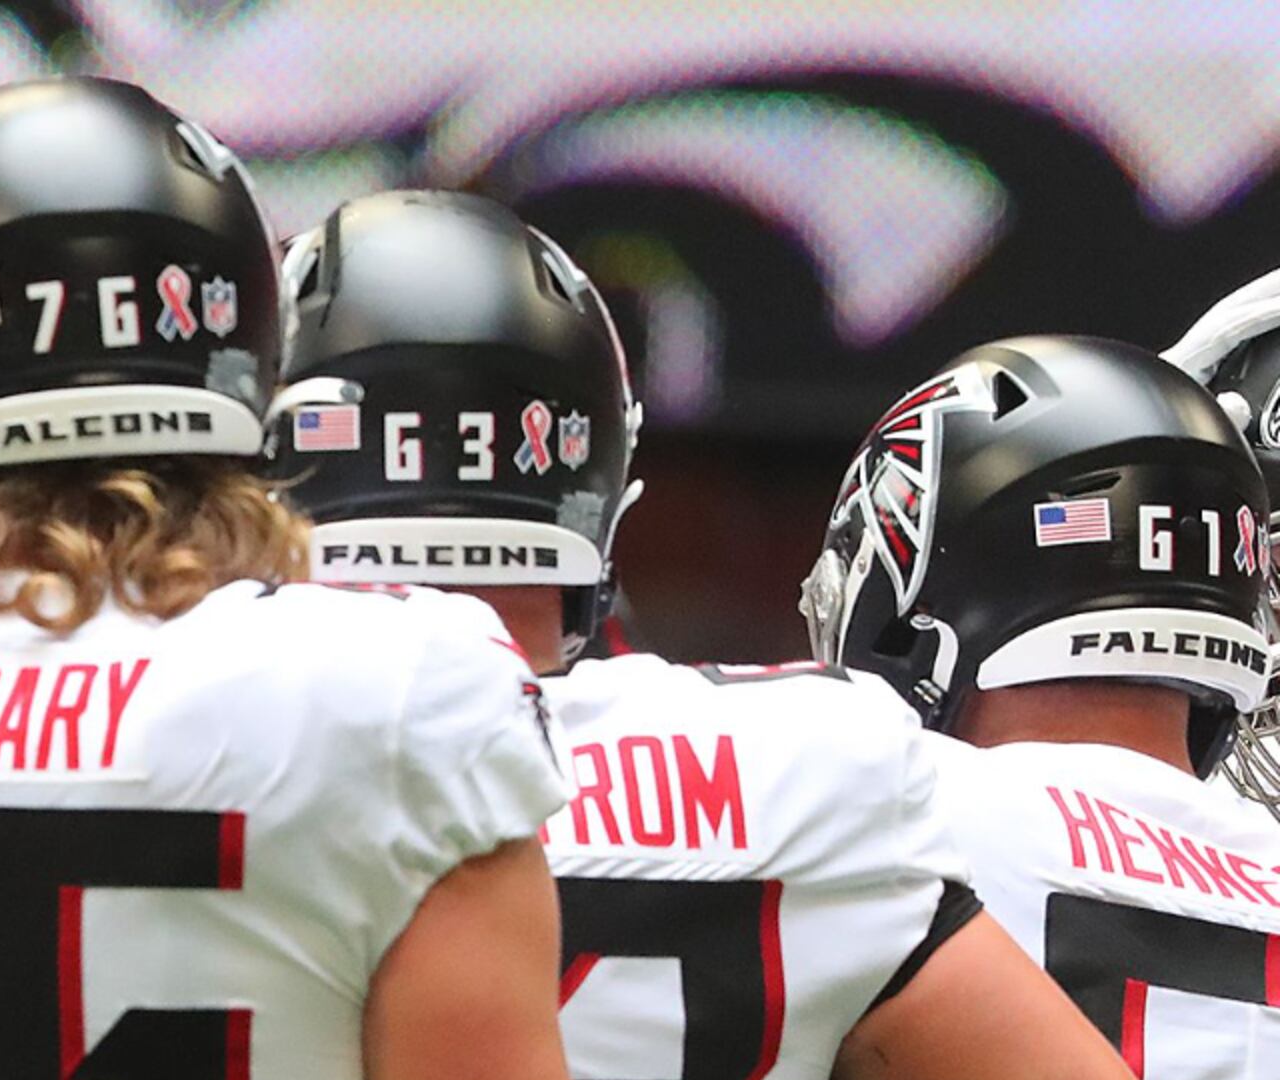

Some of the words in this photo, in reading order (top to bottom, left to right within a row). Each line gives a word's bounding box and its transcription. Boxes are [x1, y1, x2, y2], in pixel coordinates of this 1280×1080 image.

[25, 275, 143, 354] 76
[384, 411, 496, 481] 63
[322, 545, 559, 569] FALCONS
[1139, 505, 1220, 577] 61
[1070, 631, 1267, 676] FALCONS
[538, 734, 748, 850] ROM
[1045, 785, 1280, 907] HENNE
